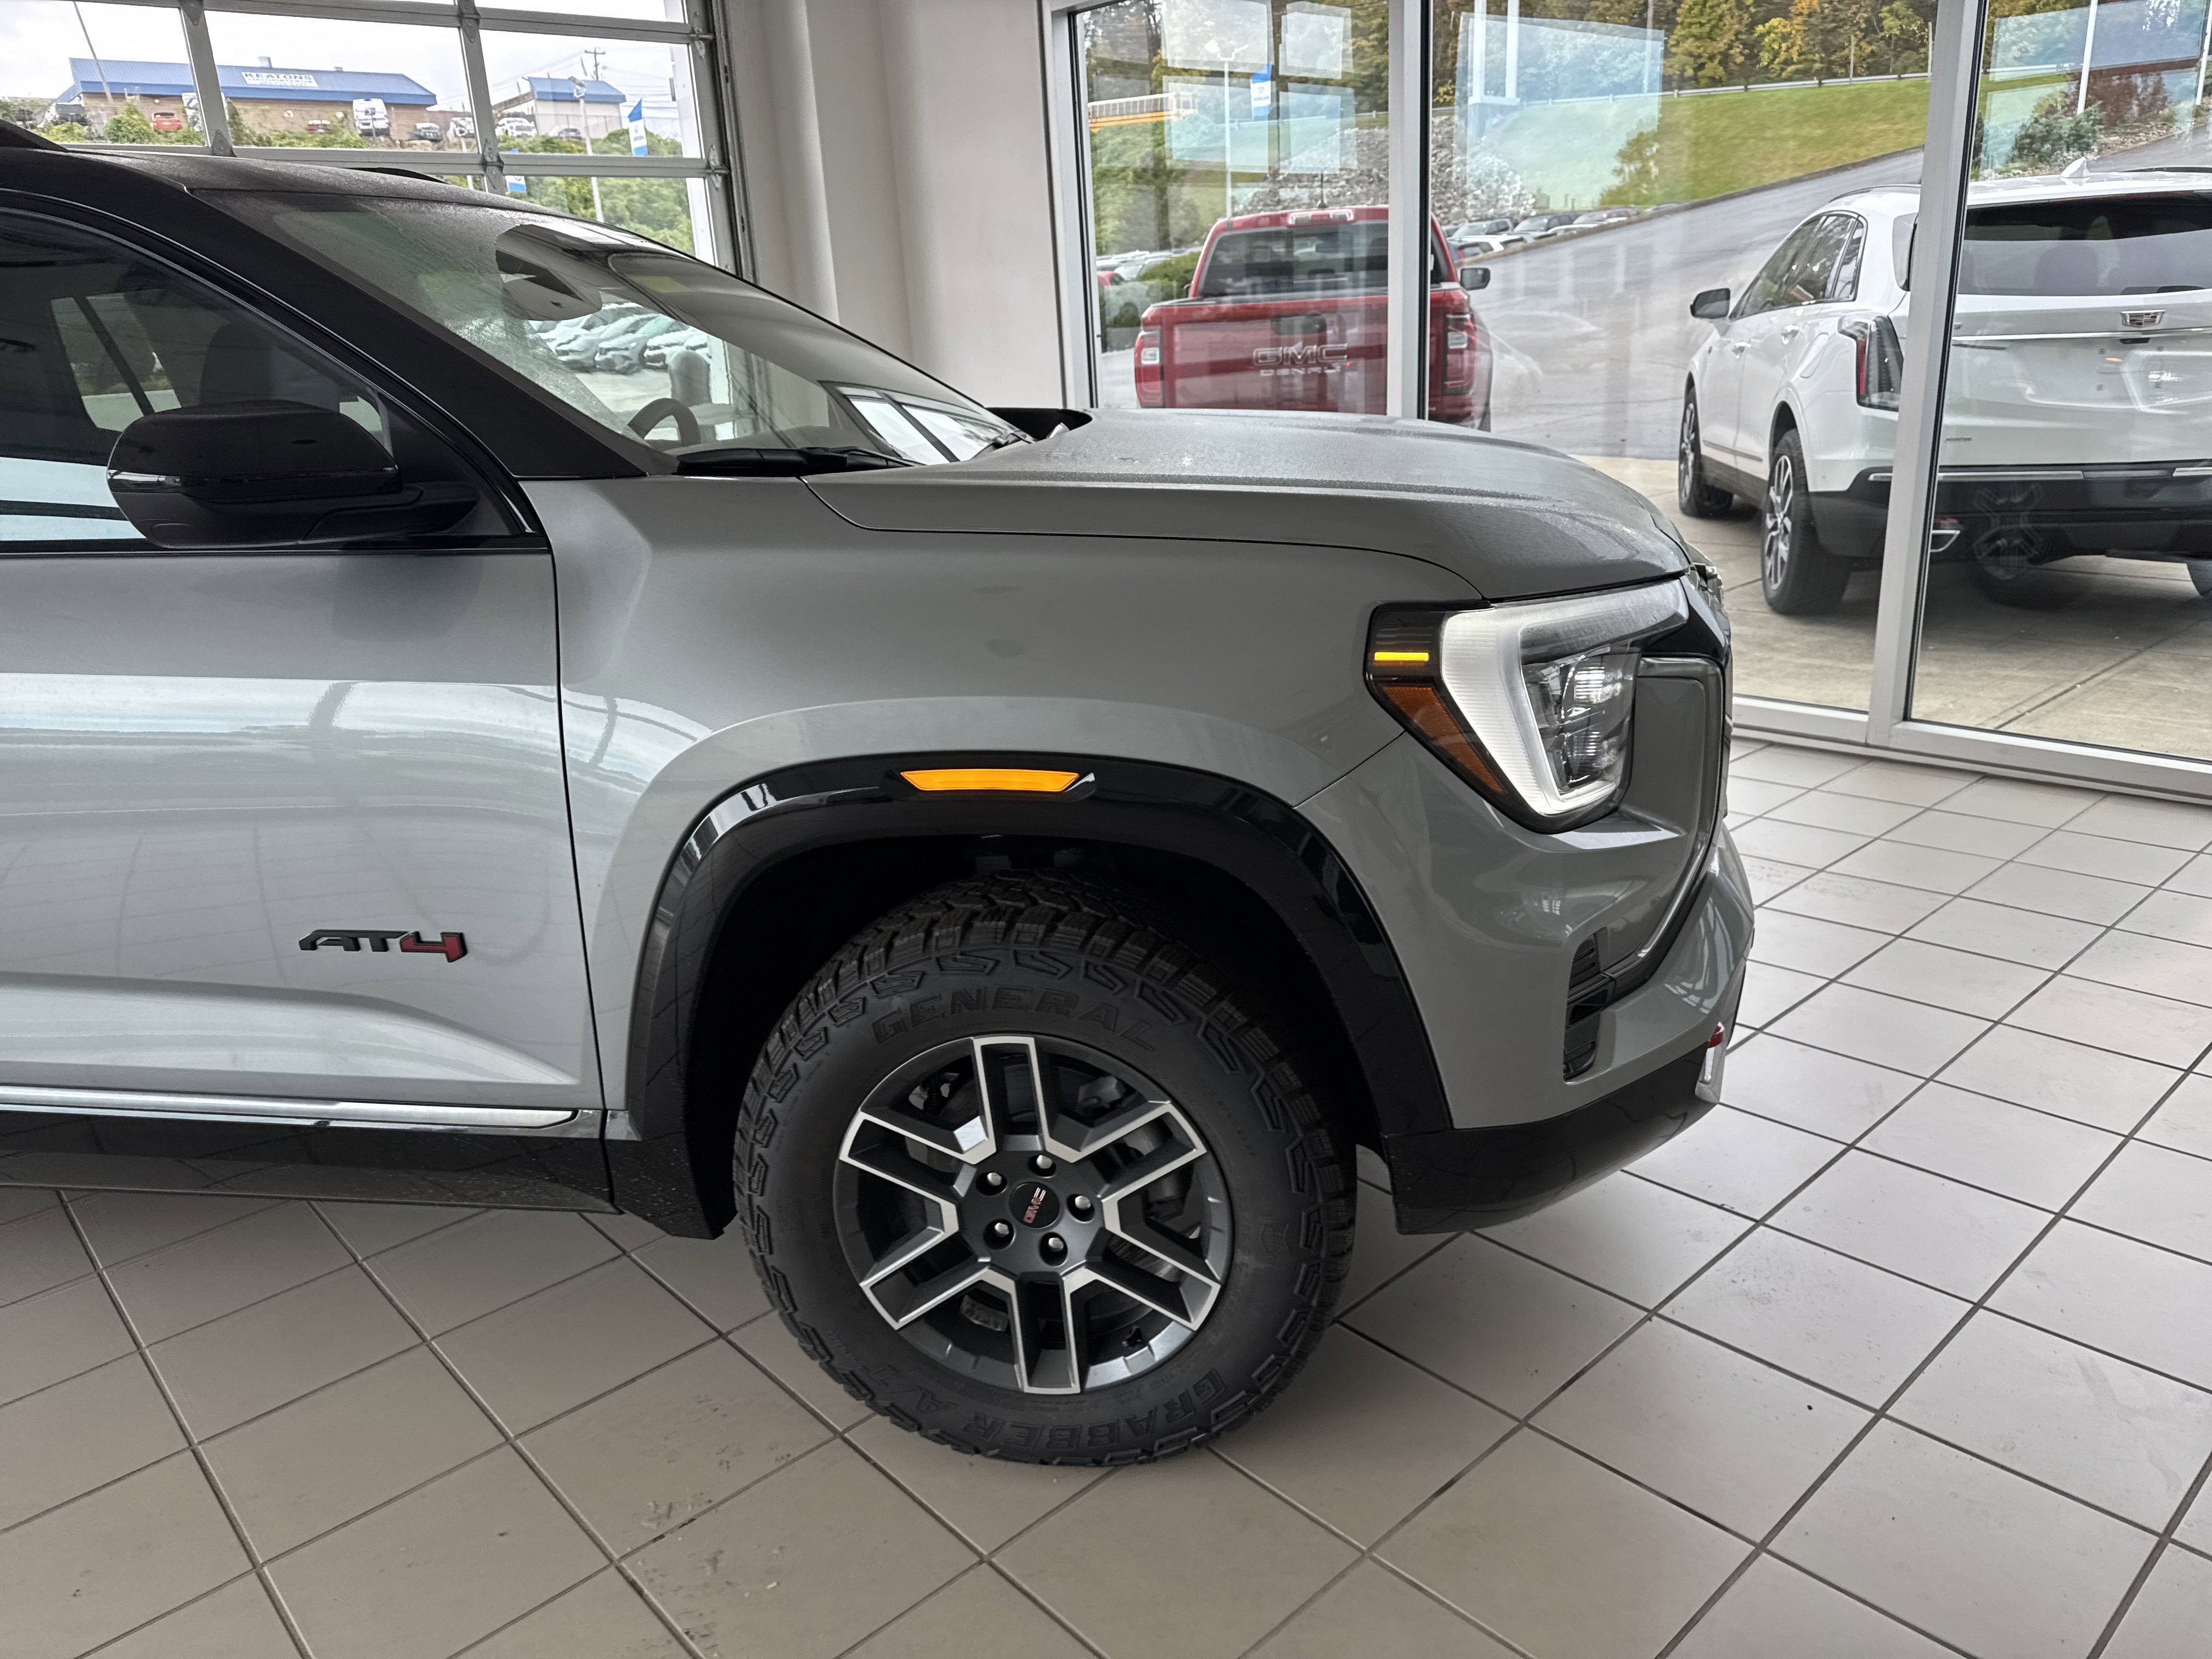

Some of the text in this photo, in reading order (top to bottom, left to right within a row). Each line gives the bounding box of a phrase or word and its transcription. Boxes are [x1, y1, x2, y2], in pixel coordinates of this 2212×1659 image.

[1253, 343, 1347, 365] GMC
[298, 929, 469, 963] AT4
[871, 985, 1155, 1052] GENERAL
[1023, 1187, 1046, 1223] GMC
[962, 1369, 1226, 1450] GRABBER
